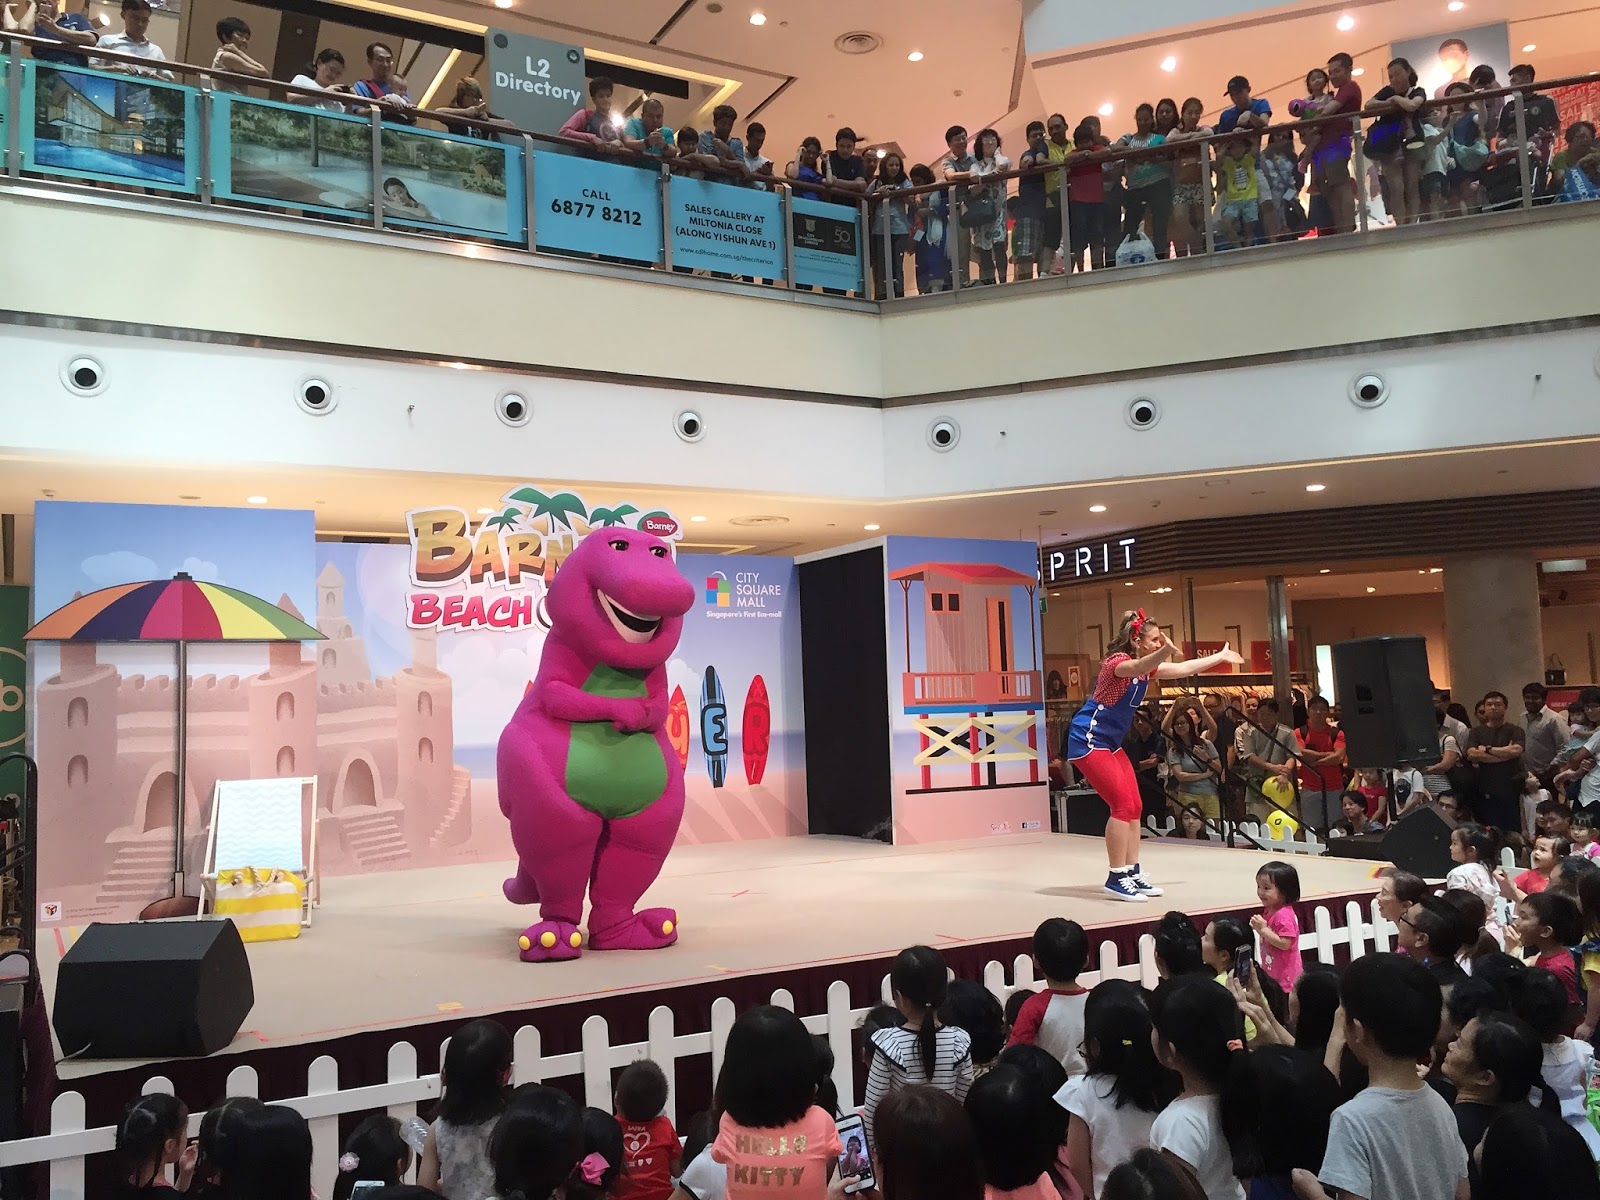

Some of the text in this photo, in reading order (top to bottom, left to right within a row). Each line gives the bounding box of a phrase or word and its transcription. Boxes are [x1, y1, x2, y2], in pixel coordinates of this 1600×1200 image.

[525, 56, 551, 78] L2
[496, 71, 581, 106] Directory
[582, 188, 611, 201] CALL
[551, 199, 642, 226] 6877 8212
[685, 203, 765, 224] SALES GALLERY AT
[689, 216, 763, 235] MILTONIA CLOSE
[675, 226, 776, 250] (ALONG YISHUN AVE 1)
[646, 520, 676, 533] Barney
[411, 509, 575, 589] BARN
[1037, 538, 1135, 581] PRIT
[735, 572, 760, 583] CITY
[736, 584, 781, 596] SQUARE
[411, 593, 532, 628] BEACH
[737, 597, 766, 608] MALL
[706, 610, 742, 619] Singapore's
[735, 1134, 807, 1156] HELLO
[735, 1164, 805, 1187] KITTY
